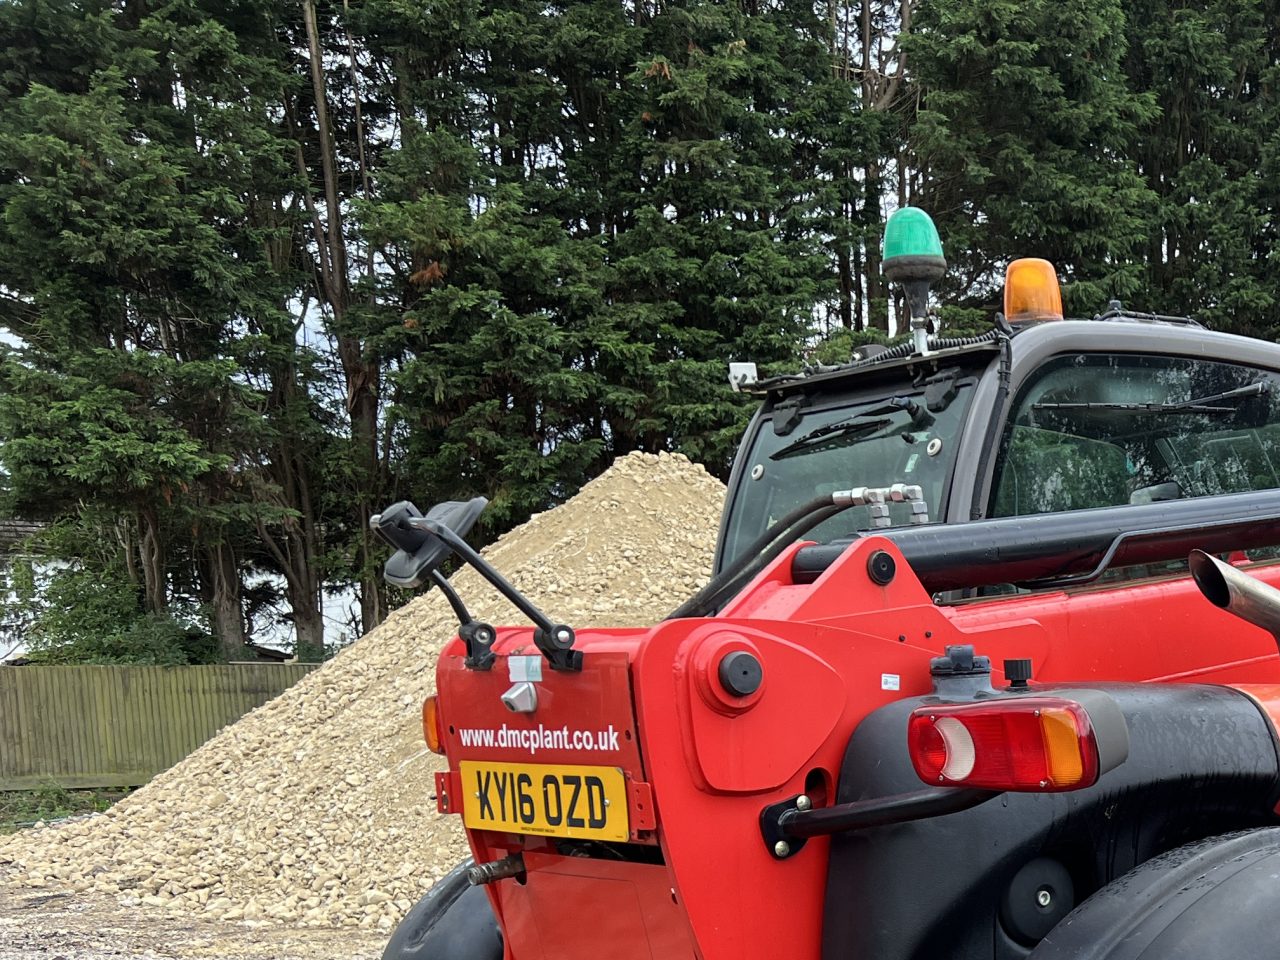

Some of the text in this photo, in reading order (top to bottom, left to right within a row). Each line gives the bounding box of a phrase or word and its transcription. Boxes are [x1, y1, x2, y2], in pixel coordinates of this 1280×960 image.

[459, 723, 620, 755] www.dmcplant.co.uk
[476, 770, 608, 830] KY16 OZD
